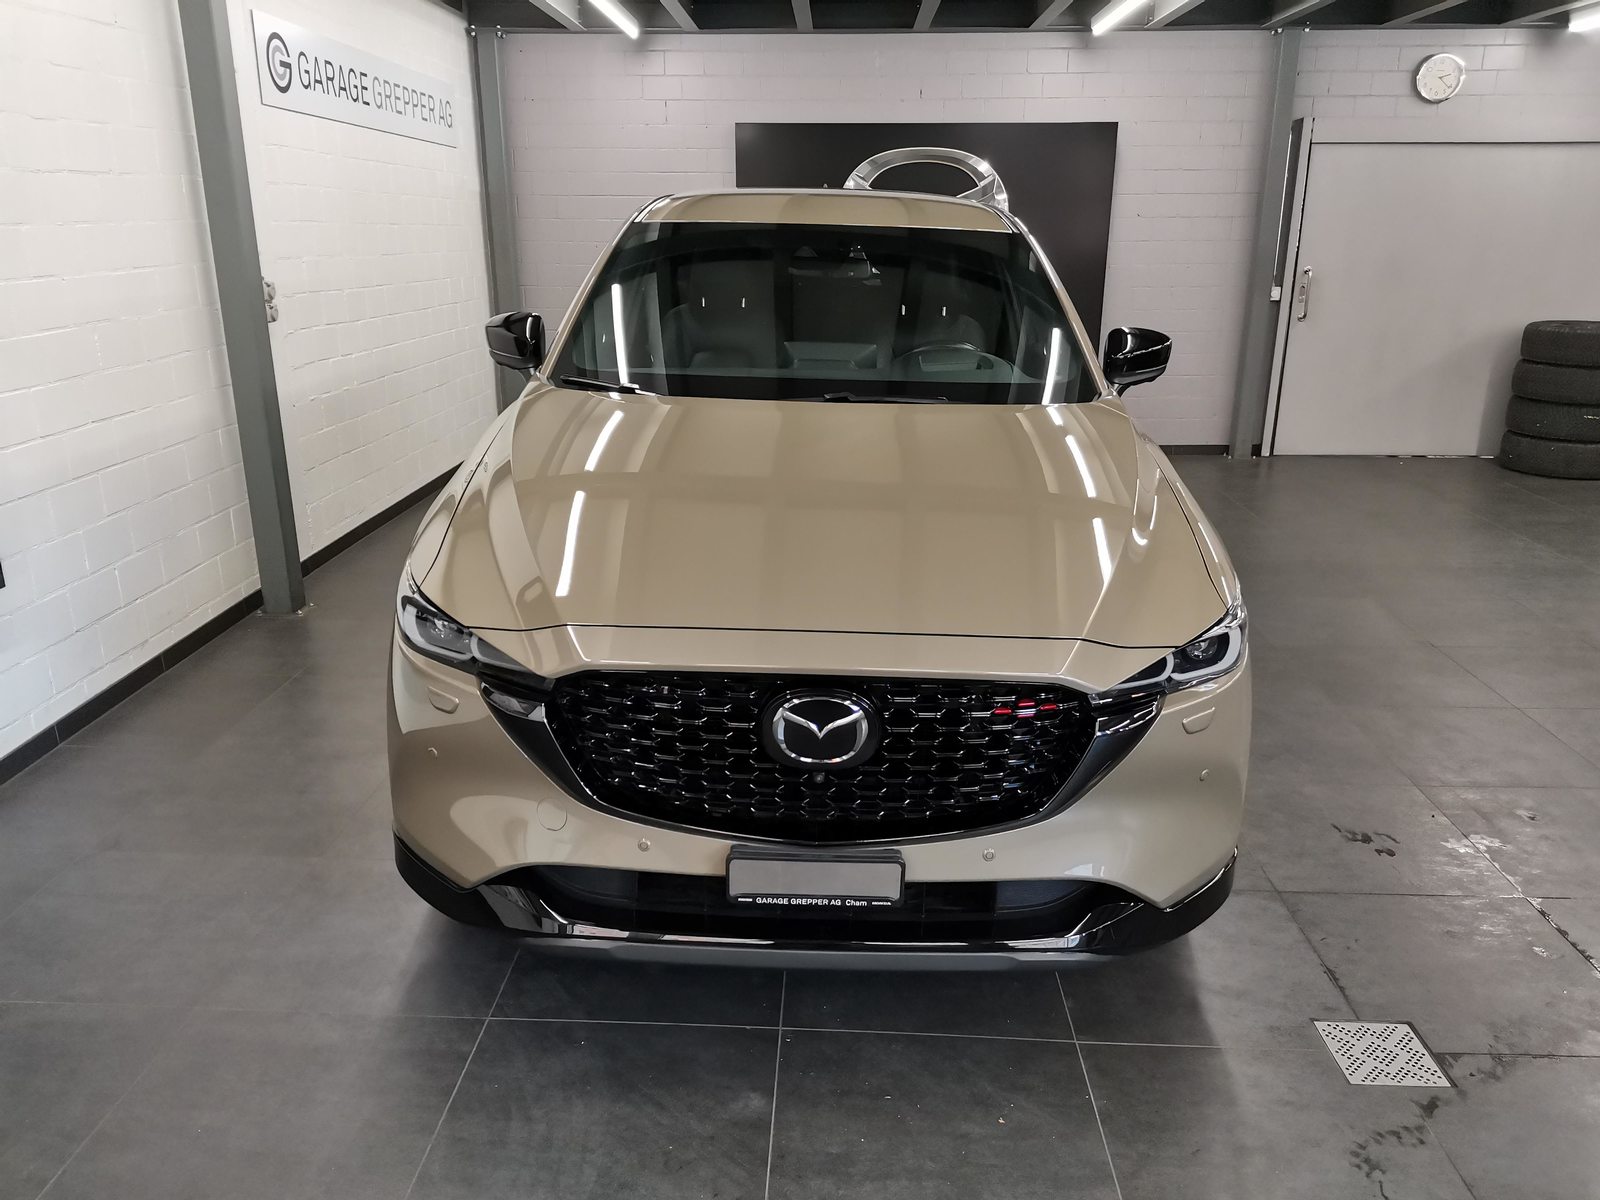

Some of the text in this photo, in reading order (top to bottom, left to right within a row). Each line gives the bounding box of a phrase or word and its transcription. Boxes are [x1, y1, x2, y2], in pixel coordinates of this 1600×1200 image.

[297, 51, 453, 128] GARAGE GREPPER AG
[756, 897, 789, 905] GARAGE
[830, 898, 841, 906] AG
[845, 899, 867, 907] Cham
